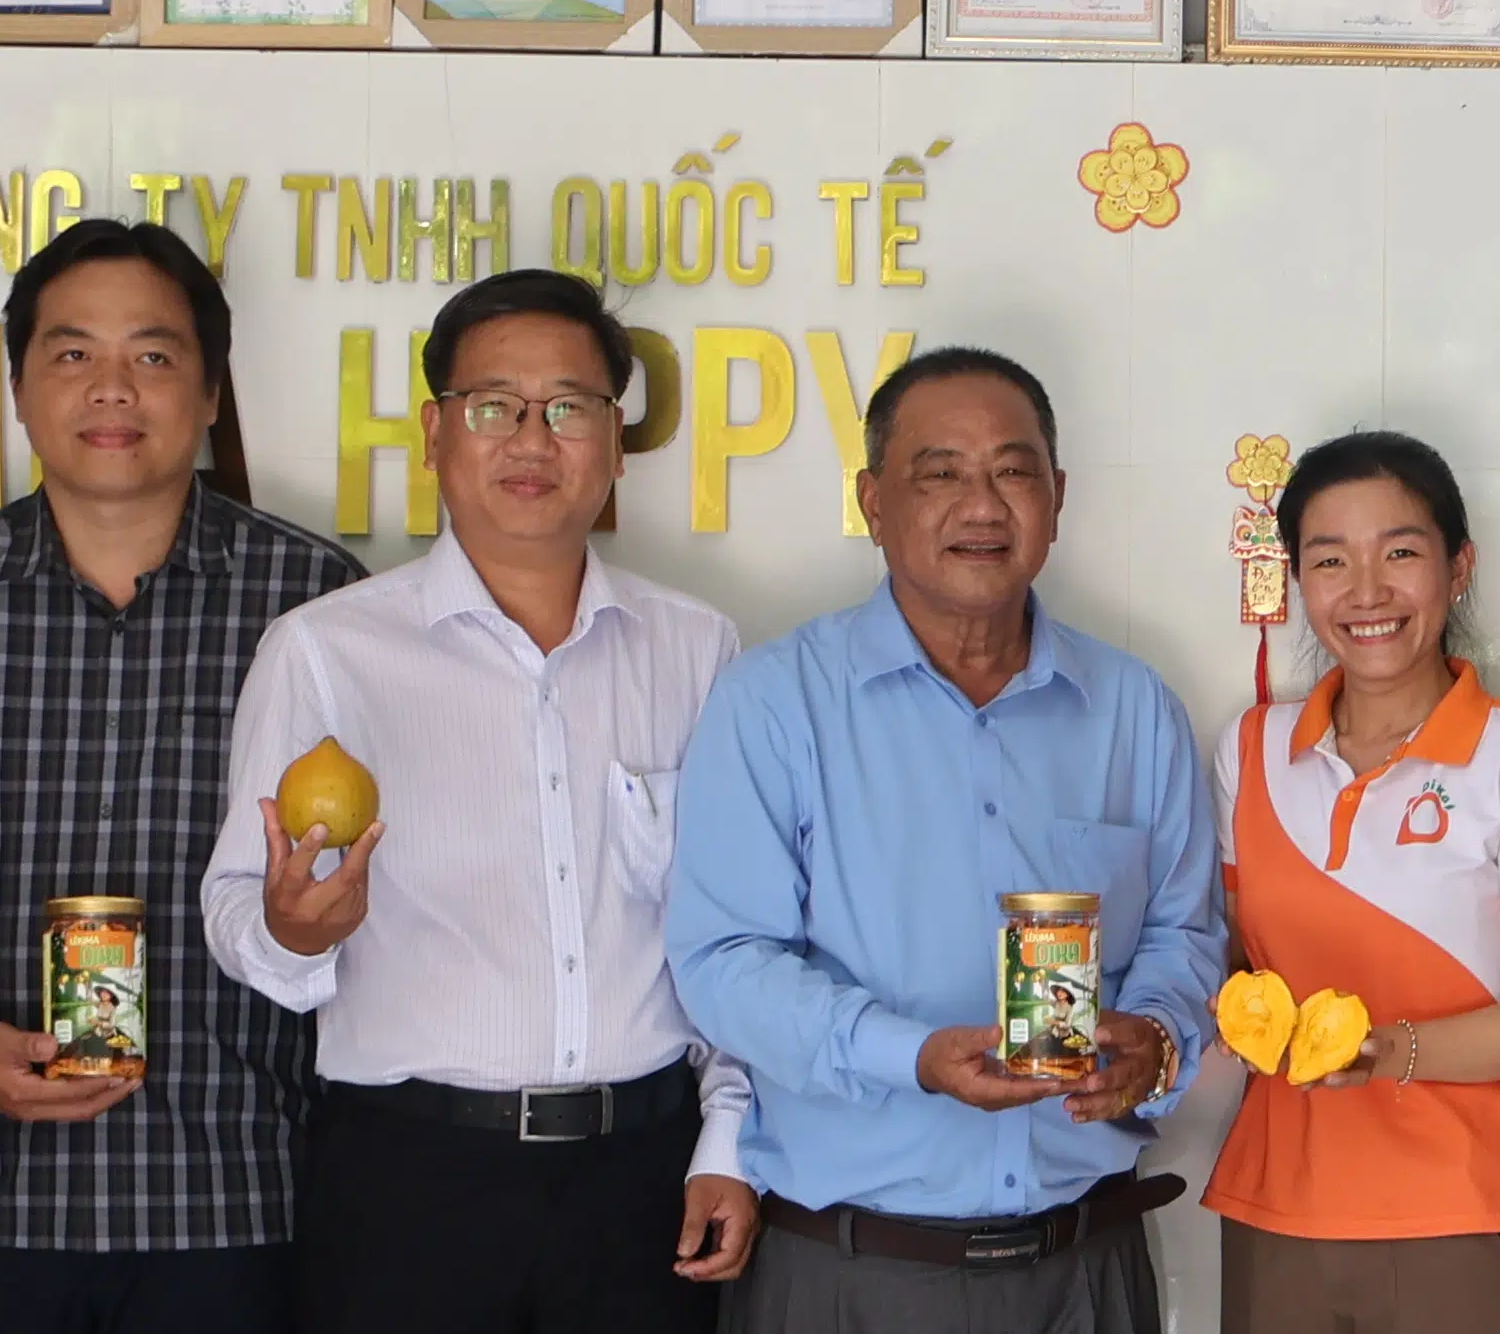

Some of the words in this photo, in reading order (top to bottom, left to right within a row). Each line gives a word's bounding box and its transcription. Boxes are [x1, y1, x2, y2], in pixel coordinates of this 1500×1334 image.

[281, 175, 509, 284] TNHH
[550, 134, 772, 286] QUỐC
[819, 140, 953, 287] TẾ
[336, 327, 916, 535] HPPY
[1035, 943, 1080, 964] DIKA
